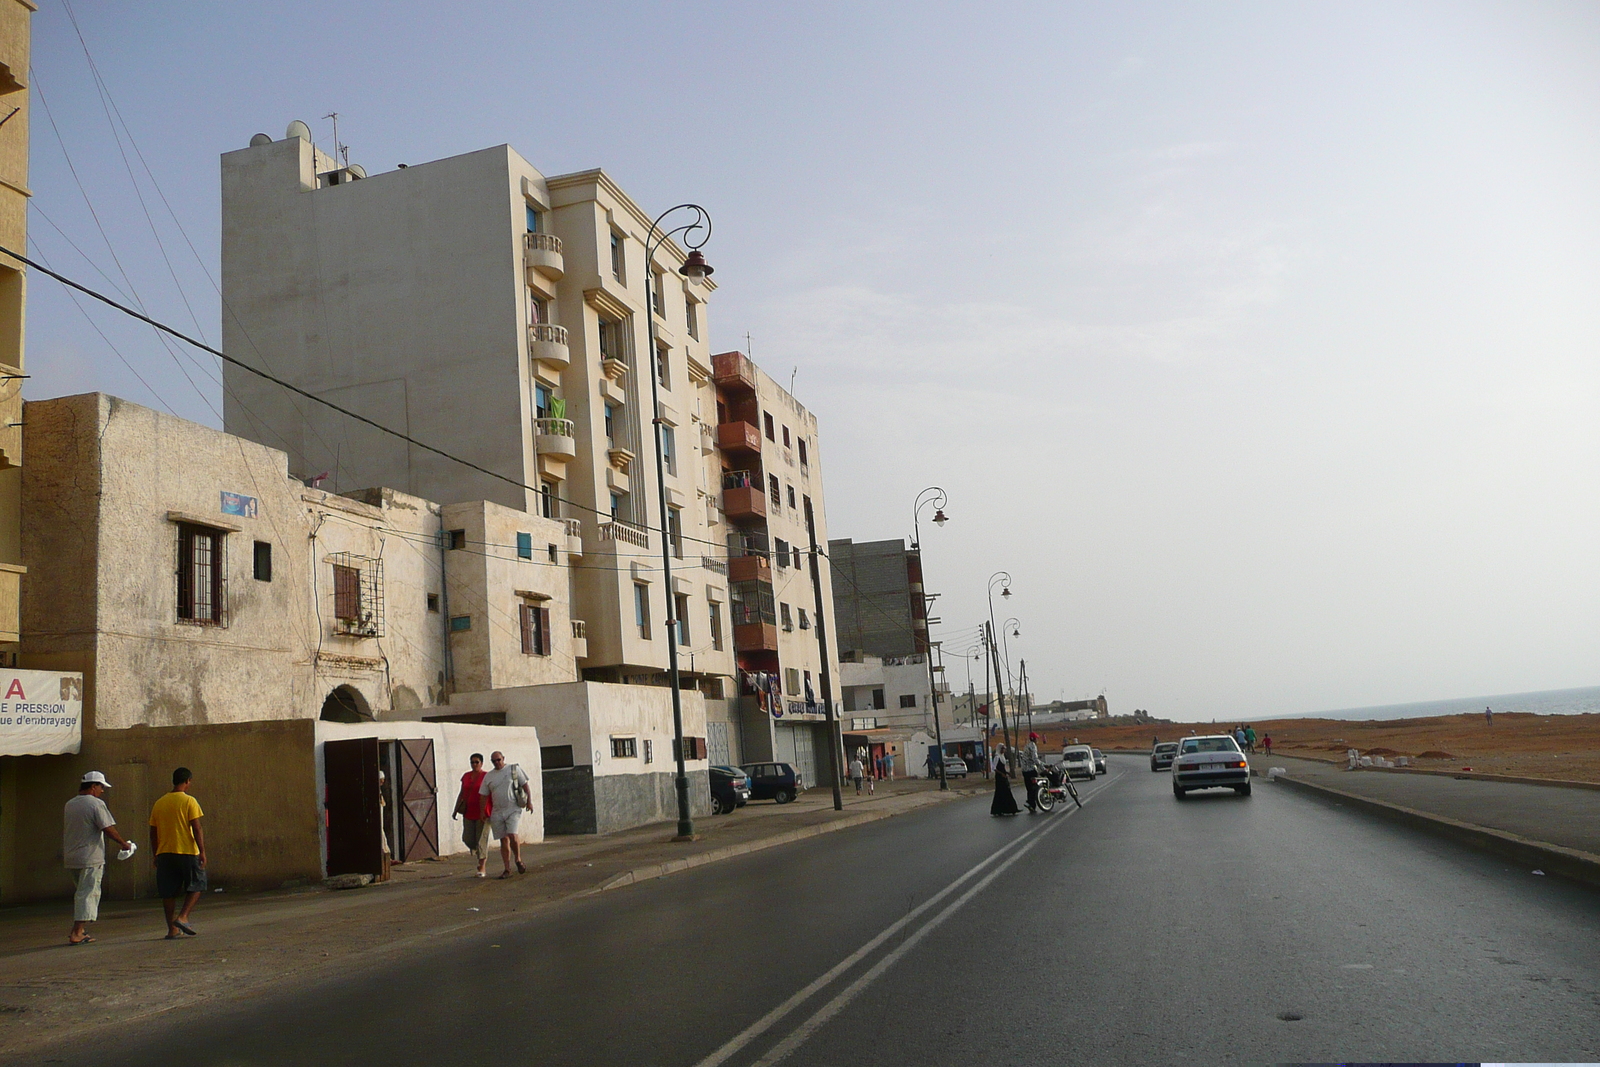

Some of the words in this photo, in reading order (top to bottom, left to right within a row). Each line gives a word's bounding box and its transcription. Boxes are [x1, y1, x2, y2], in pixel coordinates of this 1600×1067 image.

[0, 678, 26, 700] A
[15, 703, 66, 714] PRESSION
[16, 715, 77, 727] d'embrayage
